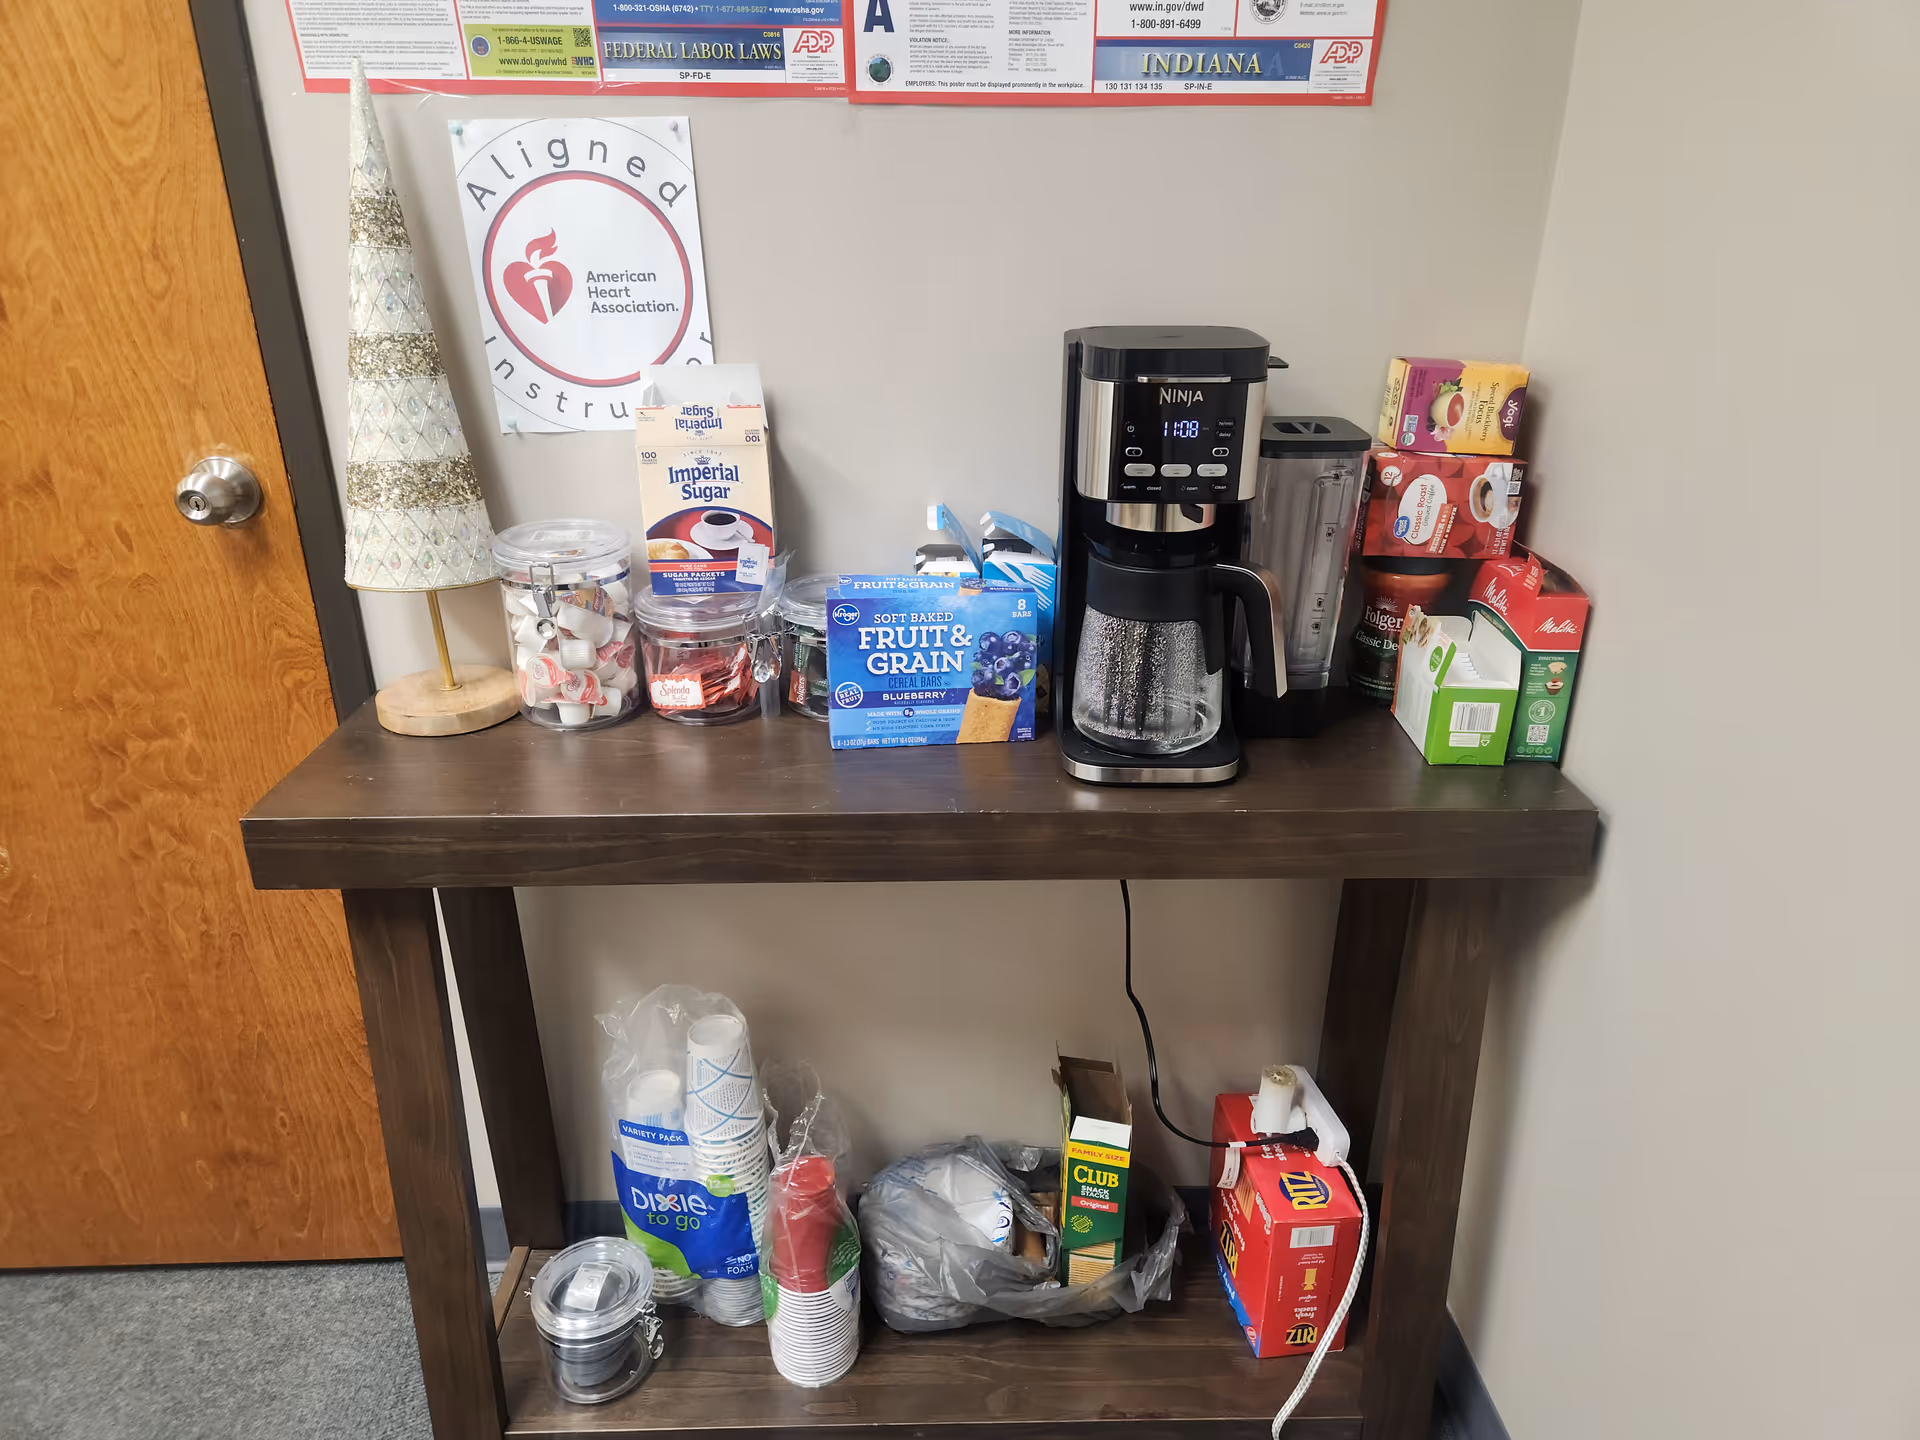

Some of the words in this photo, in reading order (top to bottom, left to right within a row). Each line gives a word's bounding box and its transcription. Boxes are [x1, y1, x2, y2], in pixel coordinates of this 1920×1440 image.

[613, 3, 671, 12] 1-800-321-OSHA
[672, 4, 694, 13] (6742)
[700, 5, 714, 13] TTY
[773, 6, 825, 15] www.osha.gov
[1129, 1, 1205, 13] www.in.gov/dwd
[1131, 18, 1201, 29] 1-800-891-6499
[497, 36, 563, 46] 1-866-4-USWAGE
[791, 30, 835, 54] ADP
[603, 41, 678, 60] FEDERAL
[680, 42, 736, 60] LABOR
[738, 42, 782, 61] LAWS
[1319, 41, 1364, 65] ADP
[499, 57, 568, 68] www.dol.gov/whd
[1141, 51, 1263, 76] INDIANA
[679, 71, 712, 80] SP-FD-E
[1105, 82, 1118, 91] 130
[1120, 82, 1132, 91] 131
[1135, 82, 1148, 91] 134
[1150, 82, 1163, 91] 135
[1183, 82, 1213, 91] SP-IN-E
[466, 138, 687, 211] Aligned
[586, 270, 657, 283] American
[587, 286, 631, 299] Heart
[1159, 386, 1204, 408] NINJA
[680, 404, 714, 418] Sugar
[1475, 399, 1489, 424] Focus
[674, 417, 723, 432] Imperial
[1163, 420, 1199, 438] 11:08
[745, 435, 761, 443] 100
[641, 451, 657, 459] 100
[667, 463, 740, 486] Imperial
[1383, 471, 1393, 481] 12
[681, 484, 731, 502] Sugar
[1416, 483, 1428, 508] Roast
[1410, 507, 1425, 539] Classic
[1017, 599, 1026, 610] 8
[834, 608, 859, 621] Kroger
[873, 613, 907, 624] SOFT
[910, 612, 954, 623] BAKED
[1011, 610, 1032, 618] BARS
[1364, 605, 1404, 631] Folger
[1534, 616, 1577, 634] Melitta
[858, 625, 948, 650] FRUIT
[950, 624, 973, 647] &
[1355, 630, 1382, 648] Classic
[866, 650, 965, 675] GRAIN
[888, 676, 919, 689] CEREAL
[920, 675, 942, 688] BARS
[659, 683, 690, 697] Splenda
[796, 675, 807, 705] Folgers
[839, 689, 859, 700] REAL
[882, 691, 947, 701] BLUEBERRY
[841, 694, 861, 705] FRUIT
[622, 1124, 657, 1140] VARIETY
[658, 1132, 684, 1143] PACK
[1071, 1147, 1104, 1158] FAMILY
[1105, 1153, 1126, 1162] SIZE
[1073, 1164, 1119, 1188] CLUB
[1080, 1190, 1110, 1200] STACKS
[1081, 1185, 1110, 1195] SNACK
[1279, 1170, 1329, 1211] RITZ
[1079, 1200, 1110, 1210] Original
[647, 1211, 669, 1226] to
[675, 1214, 700, 1232] go
[1219, 1219, 1238, 1279] RITZ
[737, 1253, 752, 1264] NO
[727, 1263, 754, 1275] FOAM
[1285, 1326, 1319, 1345] RITZ
